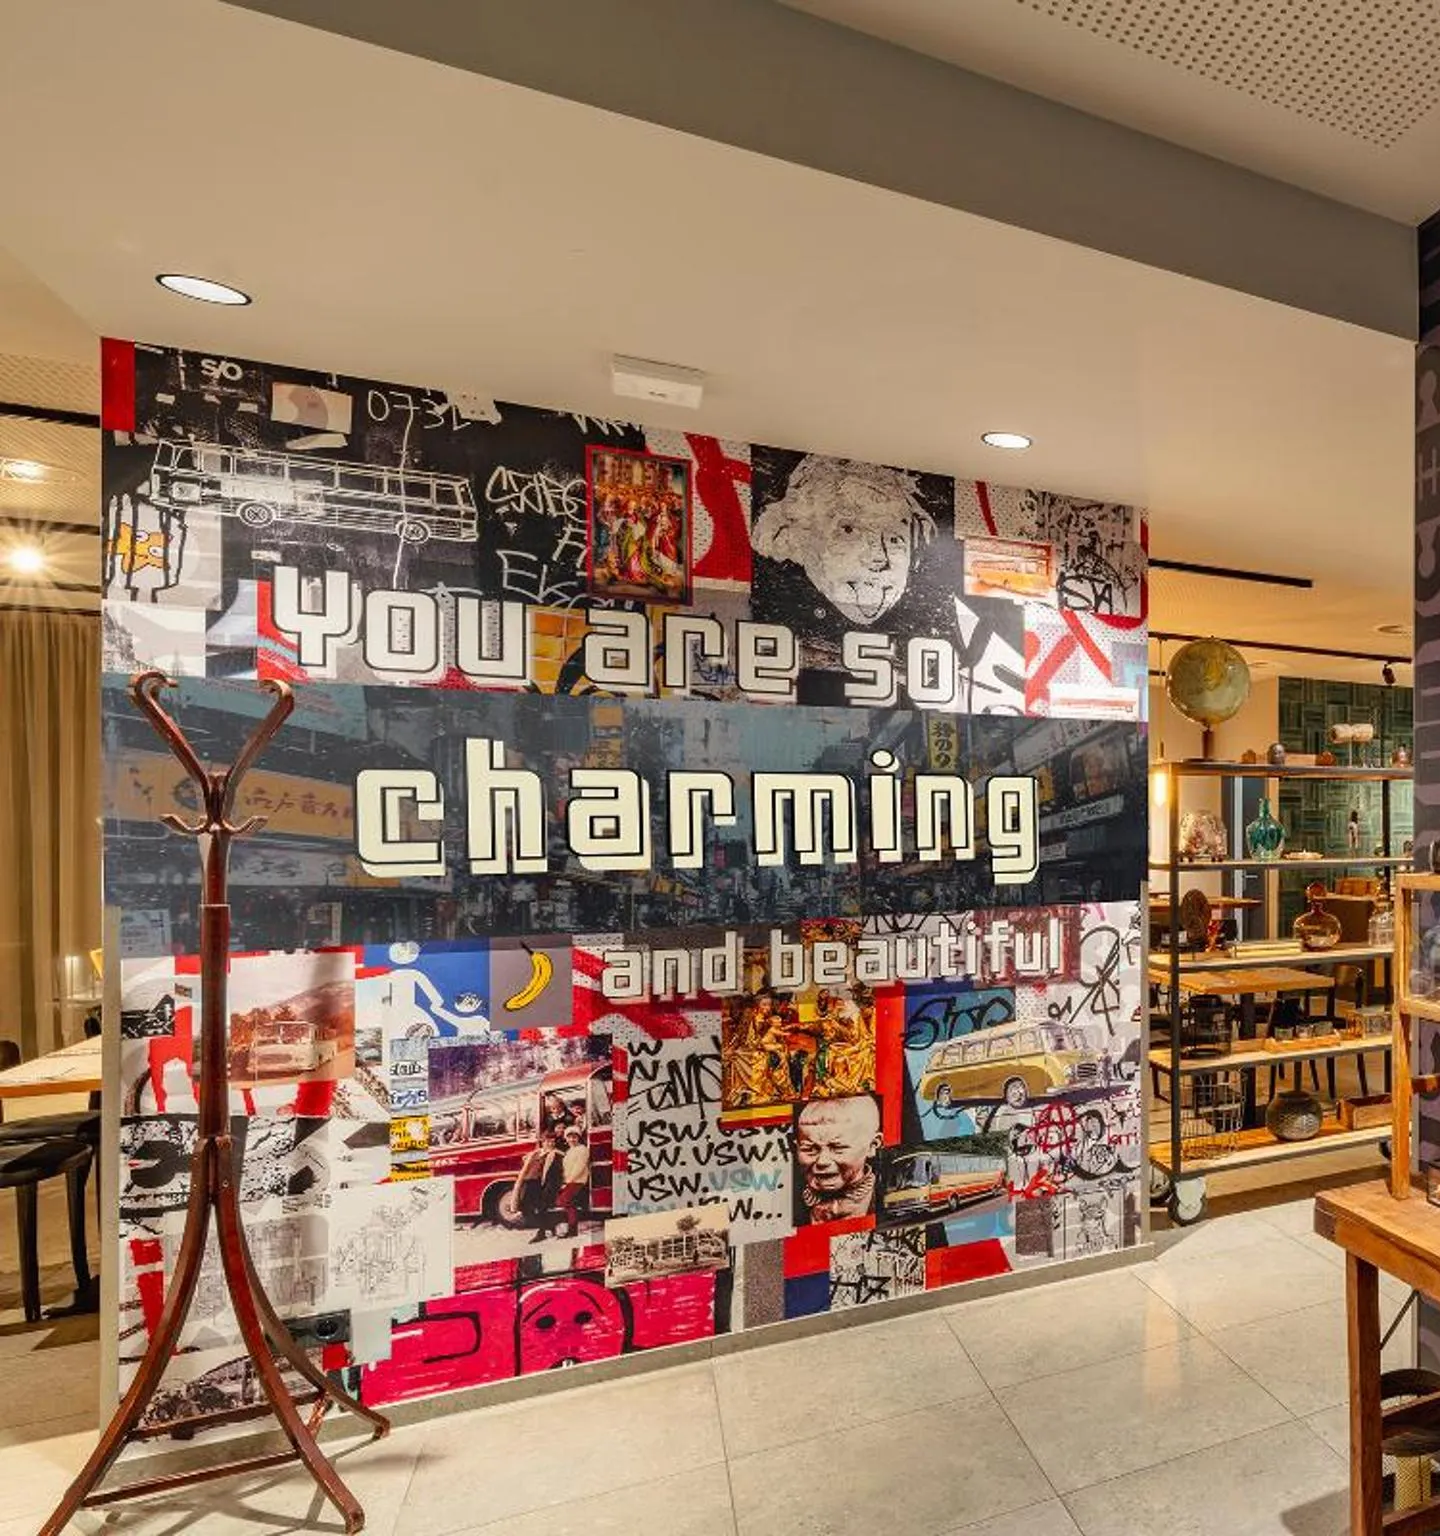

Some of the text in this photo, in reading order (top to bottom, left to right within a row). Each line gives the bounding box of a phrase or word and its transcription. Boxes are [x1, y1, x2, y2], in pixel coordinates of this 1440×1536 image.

[272, 565, 964, 712] You are so
[354, 736, 1040, 885] charming
[601, 917, 1063, 1002] and beautiful
